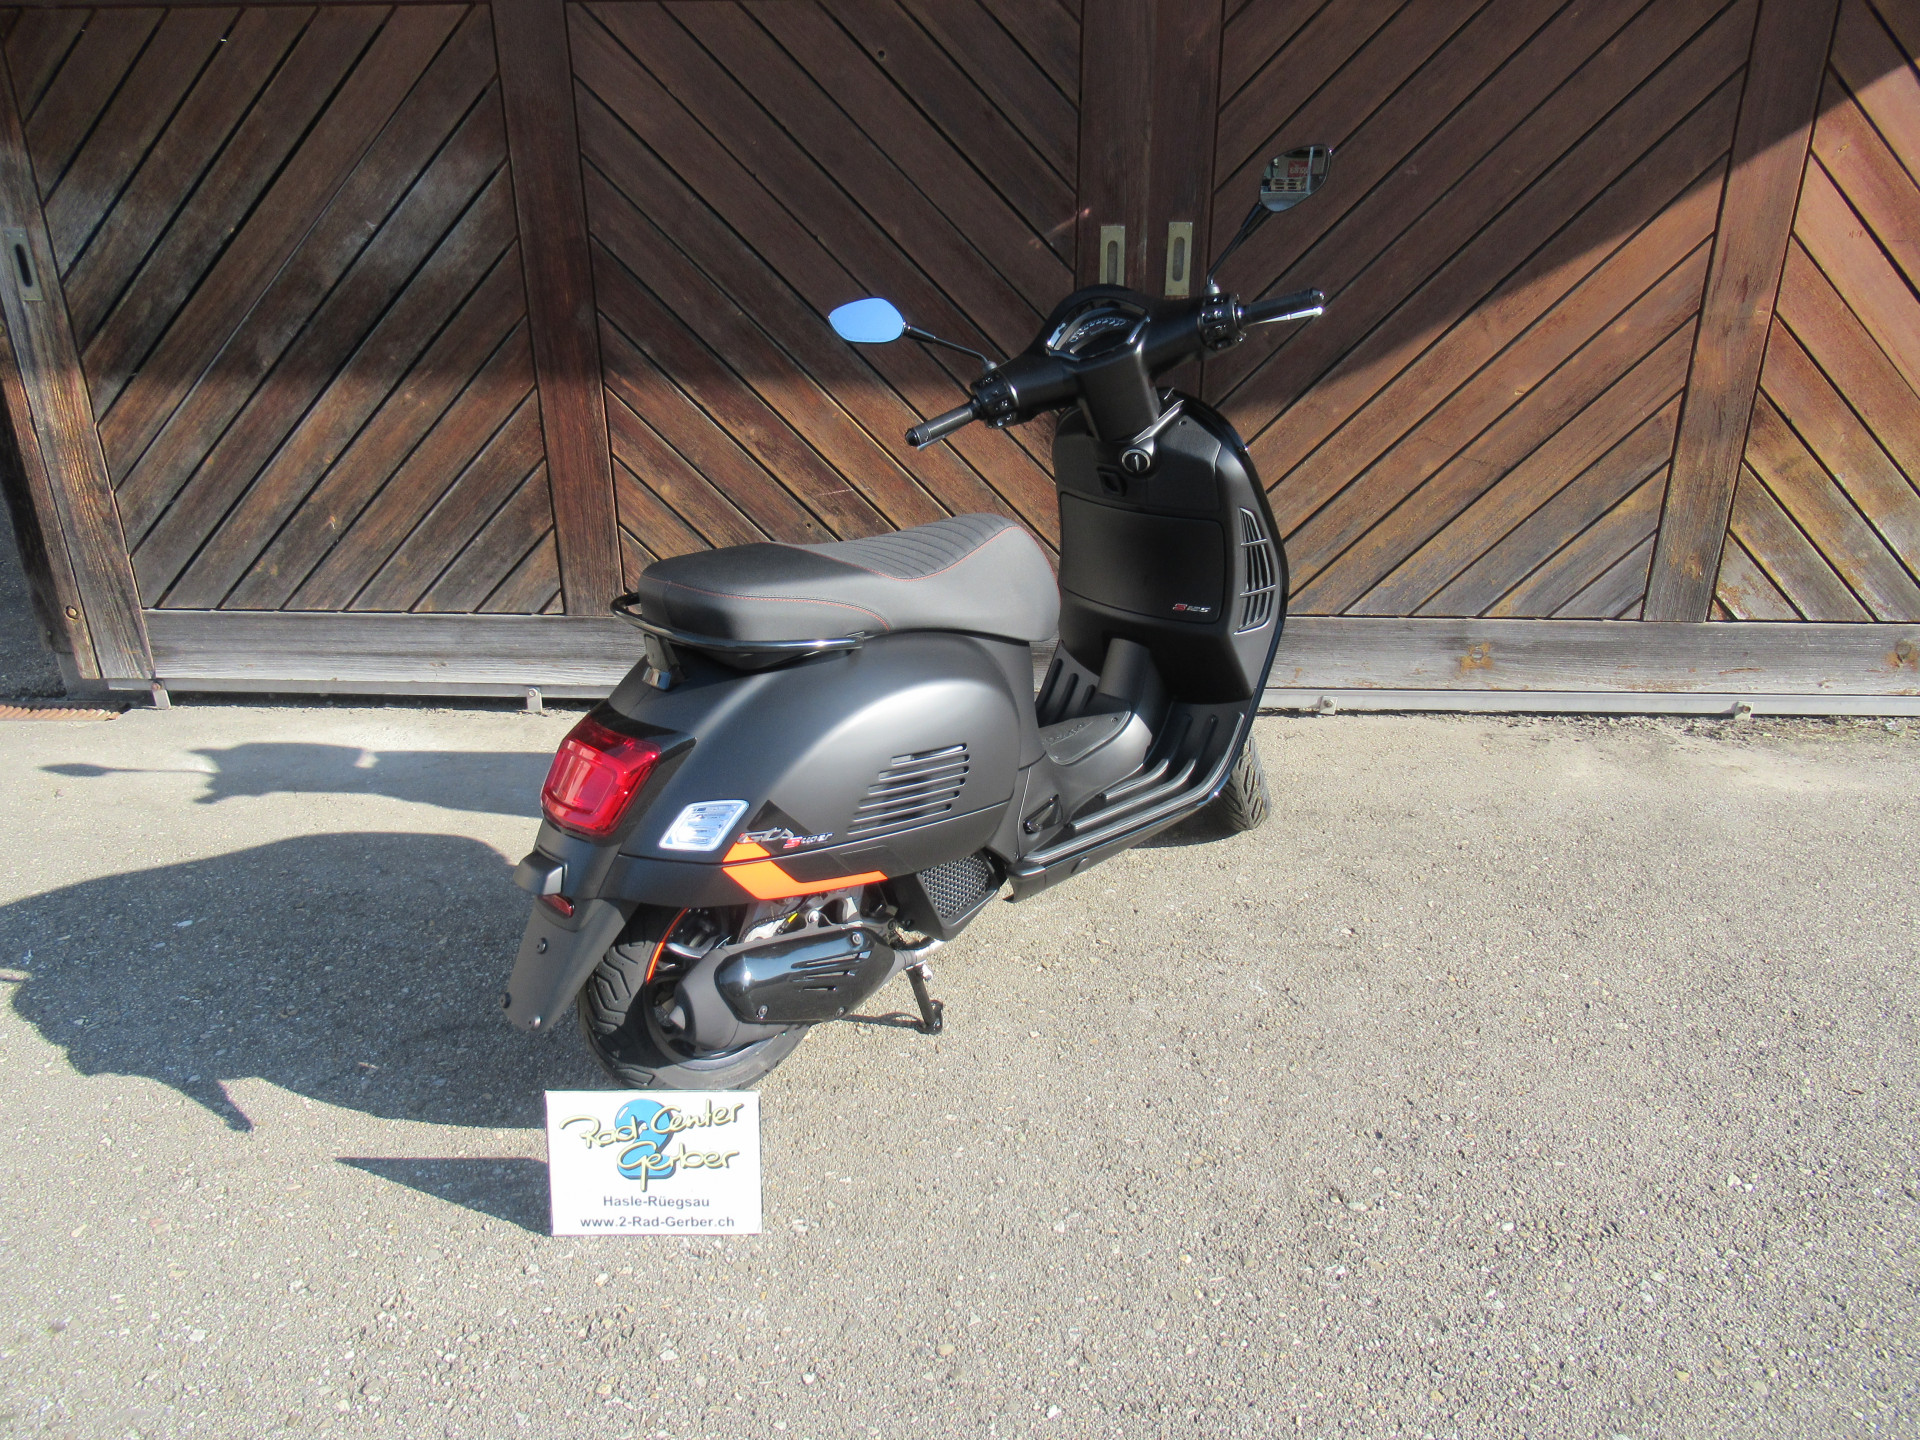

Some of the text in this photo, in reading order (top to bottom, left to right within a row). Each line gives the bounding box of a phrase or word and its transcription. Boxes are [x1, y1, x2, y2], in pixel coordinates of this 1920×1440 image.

[617, 1140, 740, 1192] Gerber
[603, 1195, 710, 1209] Hasle-Rüegsau
[580, 1216, 735, 1228] www.2-Rad-Gerber.ch
